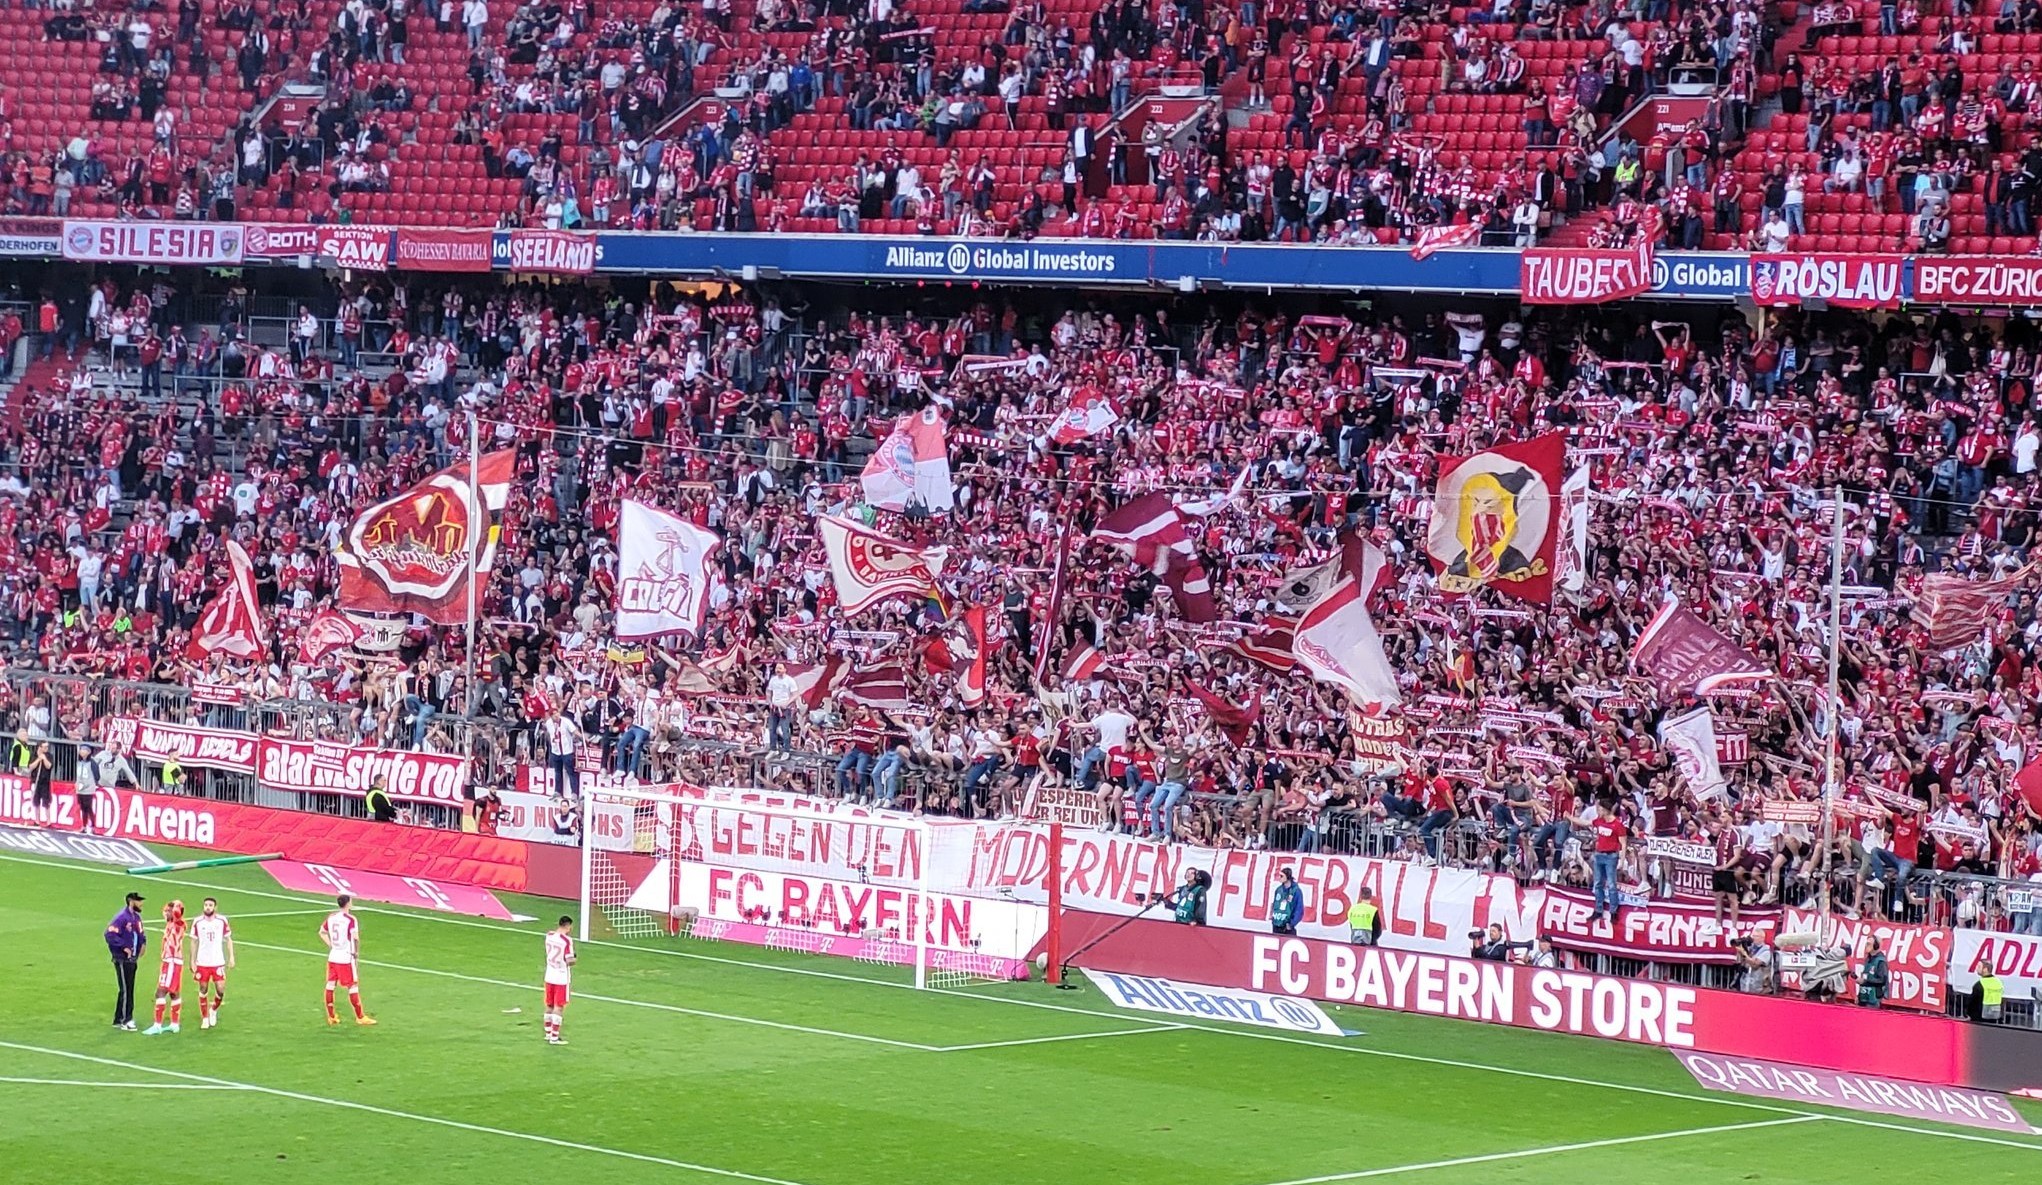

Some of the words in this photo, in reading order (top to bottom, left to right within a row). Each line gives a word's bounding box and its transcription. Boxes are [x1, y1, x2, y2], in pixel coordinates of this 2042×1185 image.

[1151, 104, 1163, 113] 222
[100, 227, 215, 258] SILESIA
[268, 231, 317, 248] ROTH
[322, 239, 387, 263] SAW
[333, 231, 374, 241] SEKTION
[451, 242, 488, 261] BAVARIA
[512, 238, 594, 271] SEELAND
[886, 246, 945, 268] Allianz
[973, 248, 1029, 270] Global
[1033, 250, 1116, 272] Investors
[1672, 262, 1742, 288] Global
[1775, 256, 1900, 301] RÖSLAU
[1919, 265, 1969, 295] BFC
[124, 794, 216, 845] Arena
[711, 793, 834, 864] GEGEN
[846, 809, 922, 881] DEN
[967, 825, 1182, 907] MODERNEN
[709, 868, 764, 921] FC
[782, 877, 972, 948] BAYERN
[1543, 899, 1615, 939] RED
[331, 923, 341, 942] 5
[1103, 973, 1277, 1024] Allianz
[1251, 936, 1311, 996] FC
[1324, 944, 1515, 1023] BAYERN
[1530, 969, 1697, 1047] STORE
[1686, 1055, 1834, 1099] QATAR
[1836, 1075, 2018, 1124] AIRWAYS
